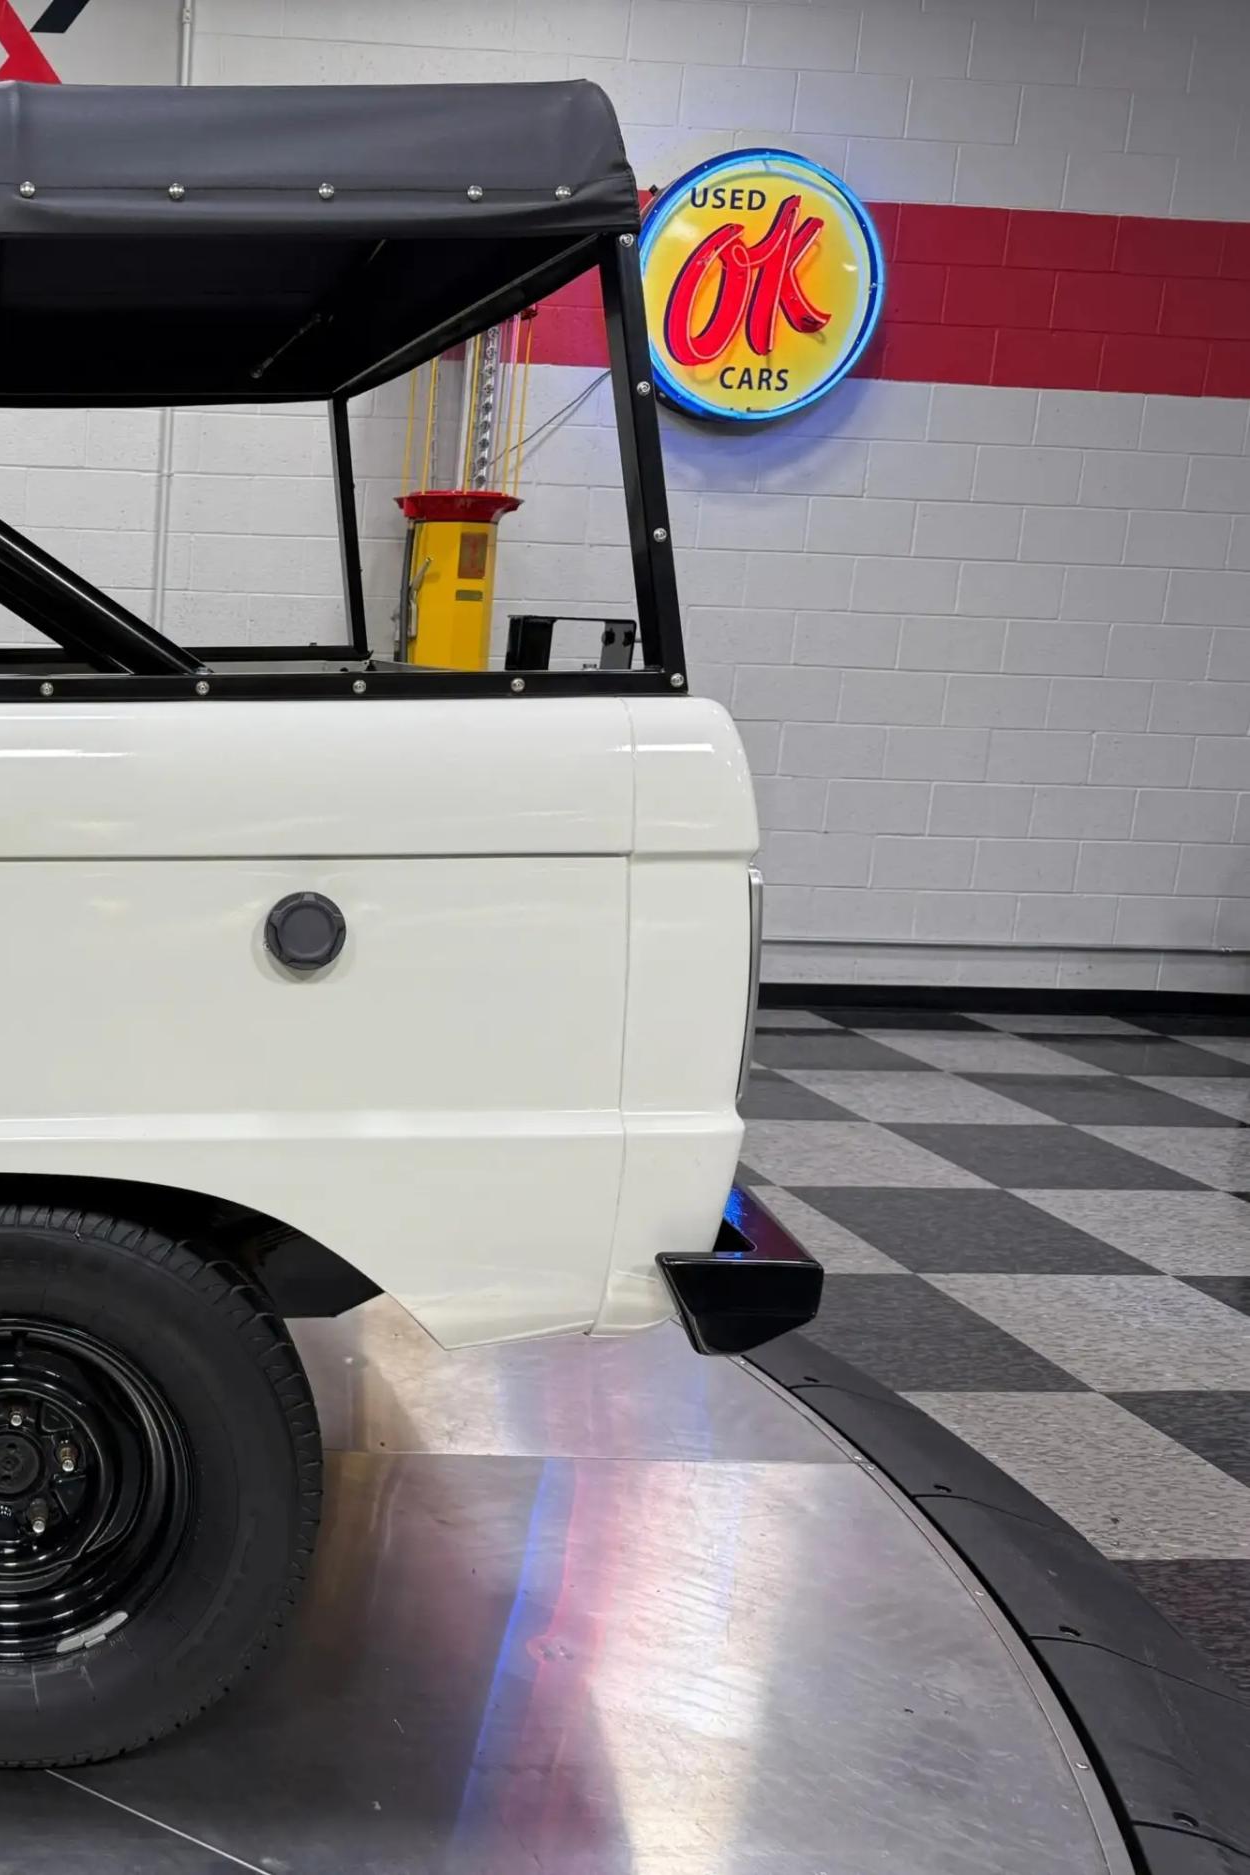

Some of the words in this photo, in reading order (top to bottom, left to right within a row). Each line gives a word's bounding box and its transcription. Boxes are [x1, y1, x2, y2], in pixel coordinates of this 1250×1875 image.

[690, 187, 767, 211] USED
[662, 195, 832, 367] OK
[719, 366, 789, 391] CARS
